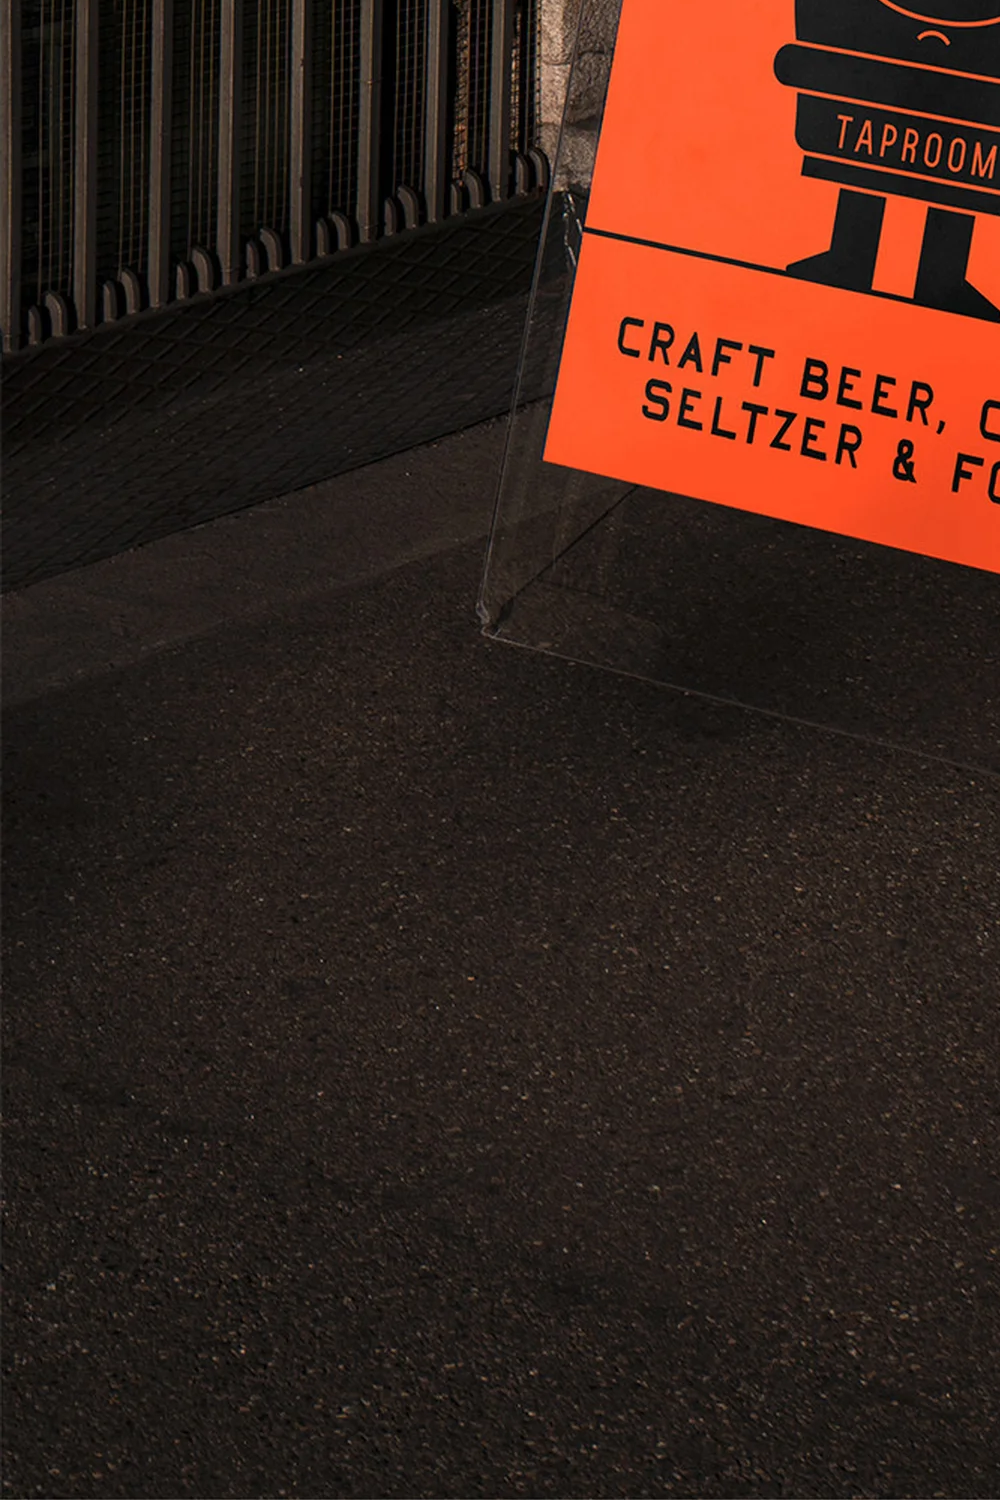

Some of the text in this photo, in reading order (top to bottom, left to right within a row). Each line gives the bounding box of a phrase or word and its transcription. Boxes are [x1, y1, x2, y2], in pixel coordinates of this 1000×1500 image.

[835, 114, 999, 181] TAPROOM
[616, 316, 775, 388] CRAFT
[799, 357, 946, 435] BEER,
[641, 378, 862, 469] SELTZER
[892, 439, 917, 483] &
